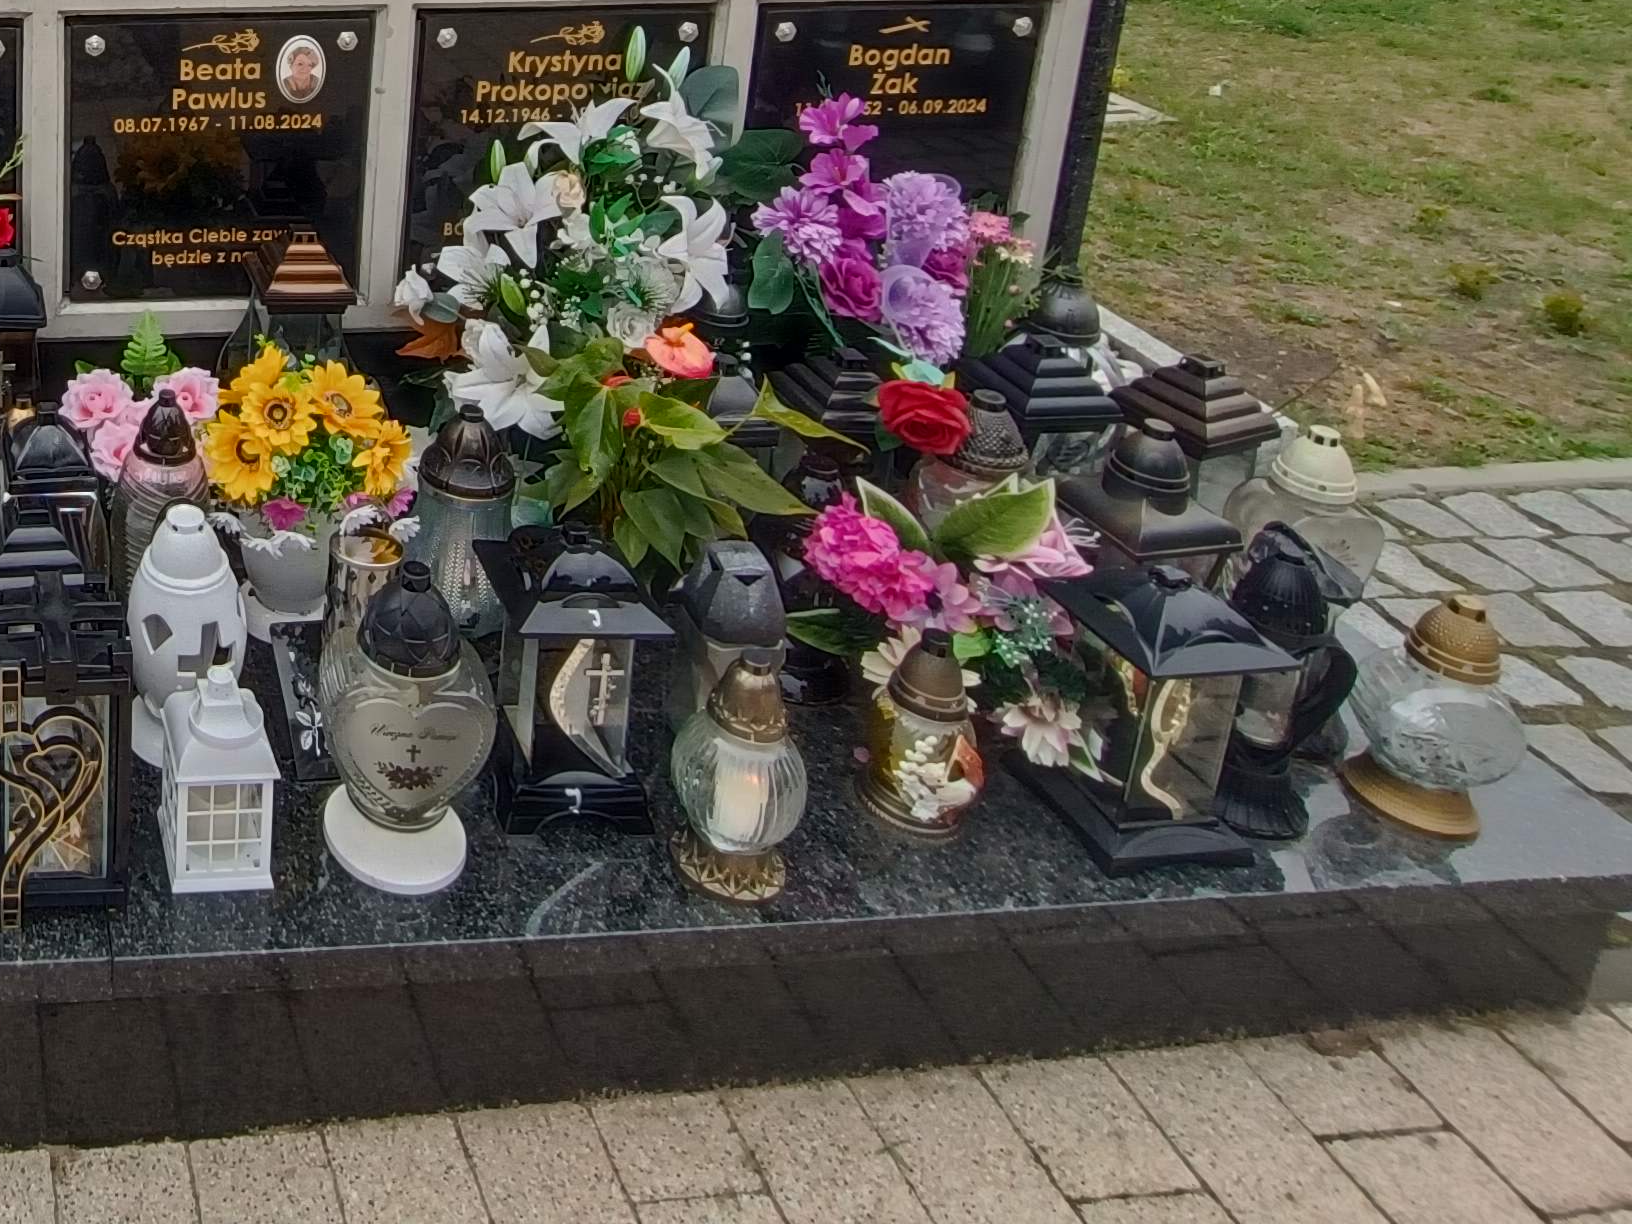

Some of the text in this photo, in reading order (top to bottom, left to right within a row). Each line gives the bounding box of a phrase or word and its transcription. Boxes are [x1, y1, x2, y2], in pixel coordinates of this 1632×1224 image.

[508, 49, 622, 80] Krystyna
[848, 43, 951, 71] Bogdan
[180, 57, 261, 81] Beata
[870, 68, 919, 94] Żak
[172, 86, 266, 110] Pawlus
[898, 98, 987, 115] 06.09.2024
[113, 113, 322, 134] 08.07.1967 11.08.2024
[461, 107, 553, 127] 14.12.1946
[112, 227, 248, 248] Cząstka Ciebie
[151, 249, 212, 268] będzie
